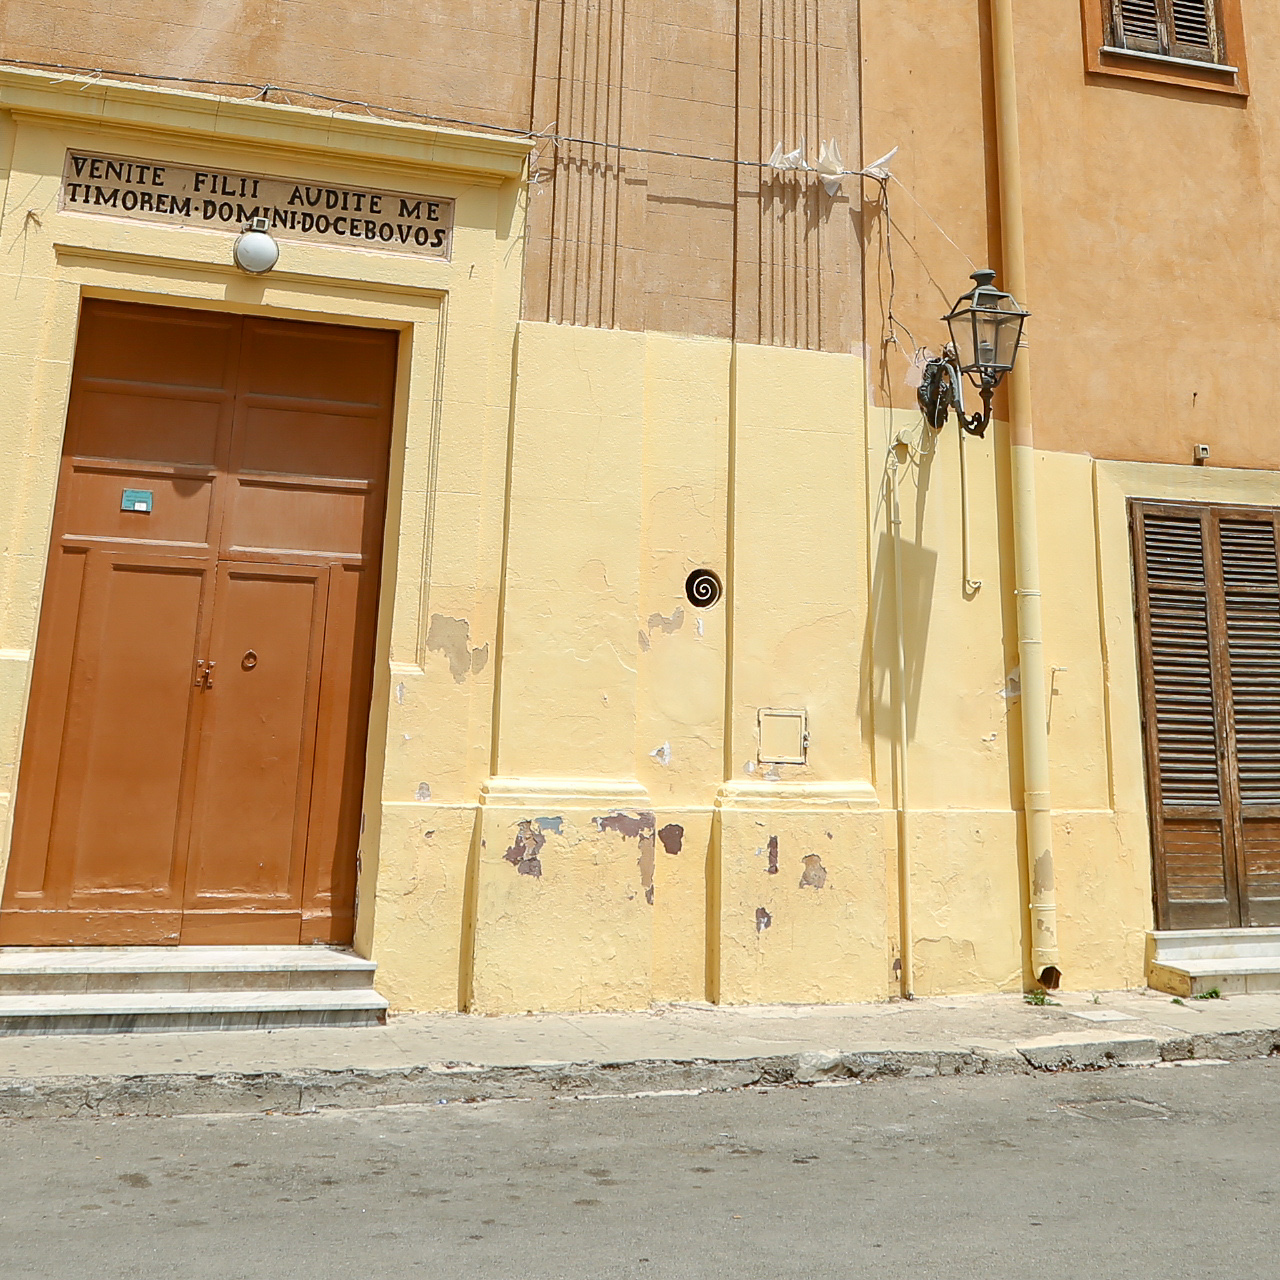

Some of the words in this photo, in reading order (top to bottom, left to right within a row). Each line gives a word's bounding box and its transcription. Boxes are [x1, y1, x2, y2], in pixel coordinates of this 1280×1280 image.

[71, 156, 166, 187] VENITE
[193, 172, 260, 199] FILII
[287, 185, 383, 215] AUDITE
[397, 198, 440, 222] ME
